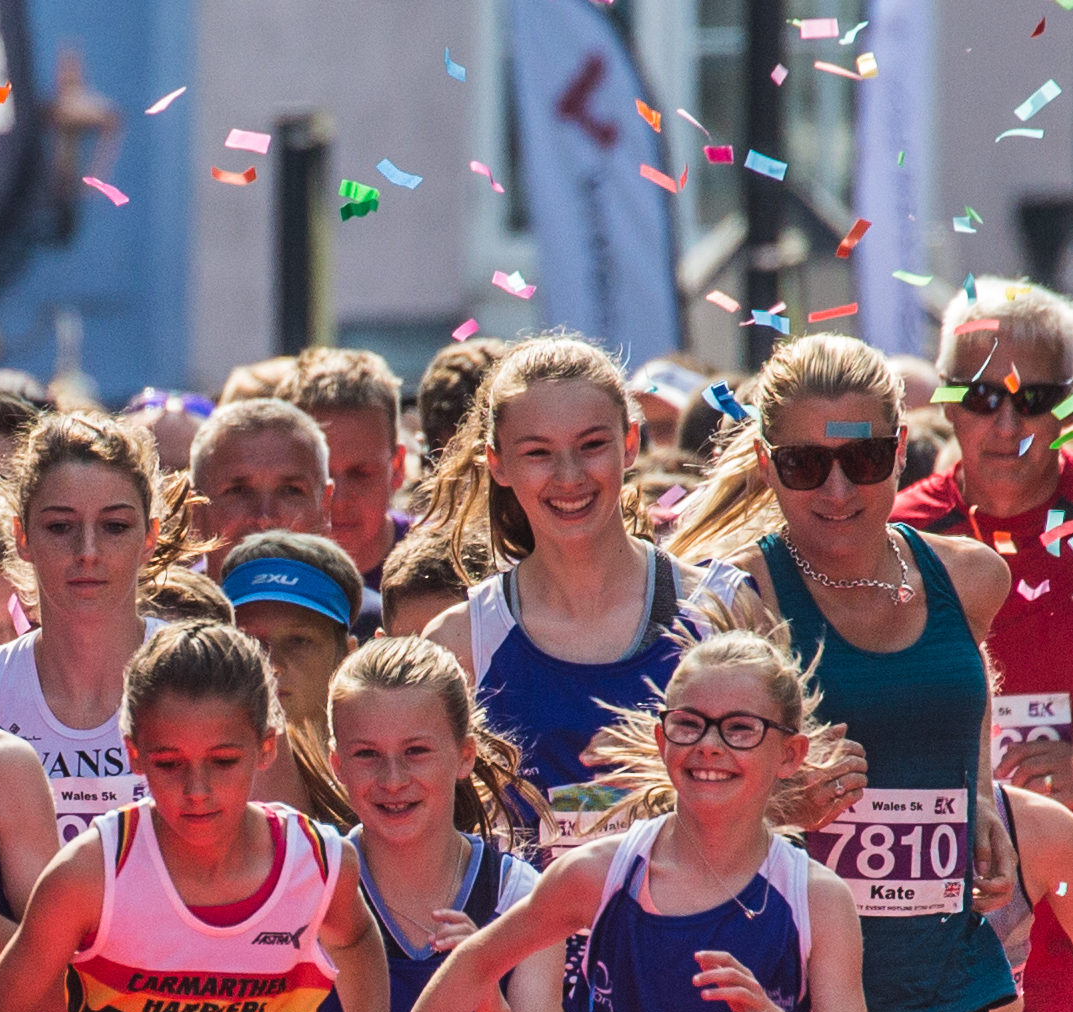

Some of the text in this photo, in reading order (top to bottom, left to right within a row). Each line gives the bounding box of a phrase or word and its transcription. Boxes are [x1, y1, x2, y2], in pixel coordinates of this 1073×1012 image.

[251, 573, 299, 586] 2XU
[1028, 701, 1054, 717] 5K
[42, 747, 134, 777] ANS
[61, 791, 98, 801] Wales
[101, 791, 117, 801] 5k
[872, 796, 955, 814] Wales 5k 5K
[819, 824, 958, 879] 7810
[870, 885, 915, 900] Kate
